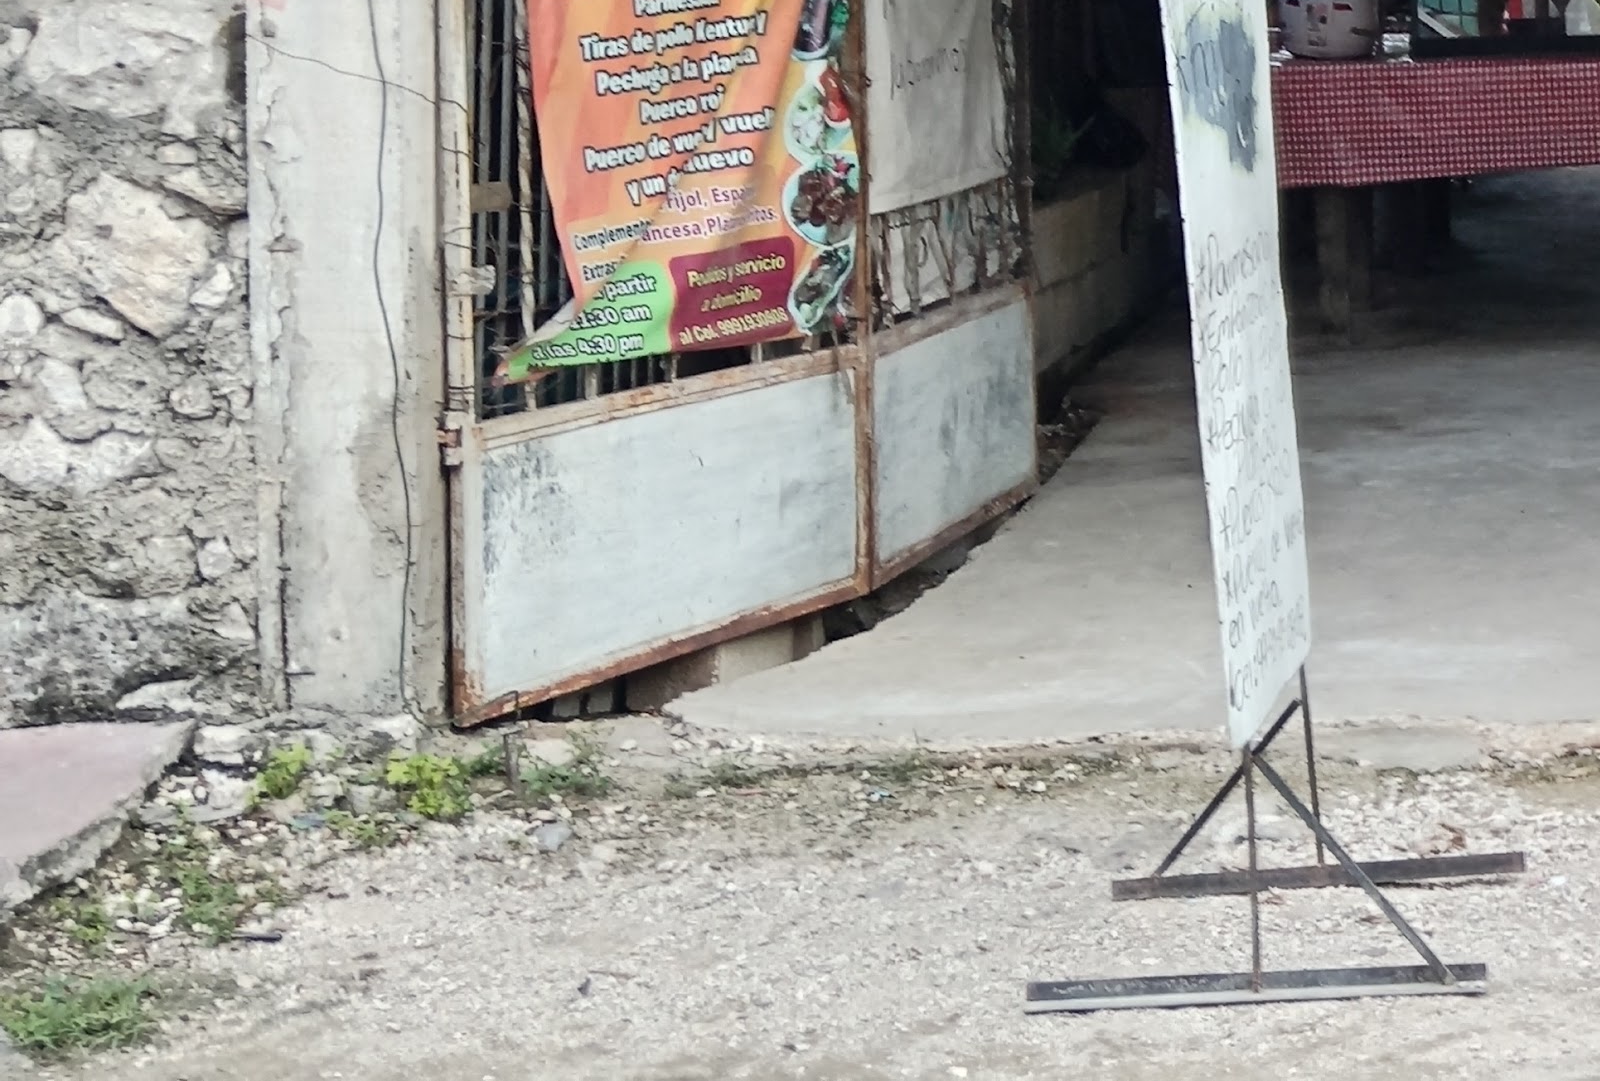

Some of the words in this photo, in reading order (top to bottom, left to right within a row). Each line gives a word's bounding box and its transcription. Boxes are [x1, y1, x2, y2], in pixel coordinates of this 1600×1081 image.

[578, 32, 631, 62] Tiras
[630, 27, 655, 55] de
[655, 21, 695, 56] pollo
[681, 55, 702, 80] la
[638, 94, 700, 125] Puerco
[582, 140, 646, 173] Puerco
[645, 132, 672, 160] de
[718, 104, 777, 136] vuel
[624, 177, 643, 207] y
[640, 172, 667, 198] un
[603, 273, 657, 302] partir
[621, 304, 653, 324] am
[546, 342, 579, 360] las
[575, 333, 618, 356] 4:30
[618, 333, 645, 358] pm
[678, 326, 694, 346] al
